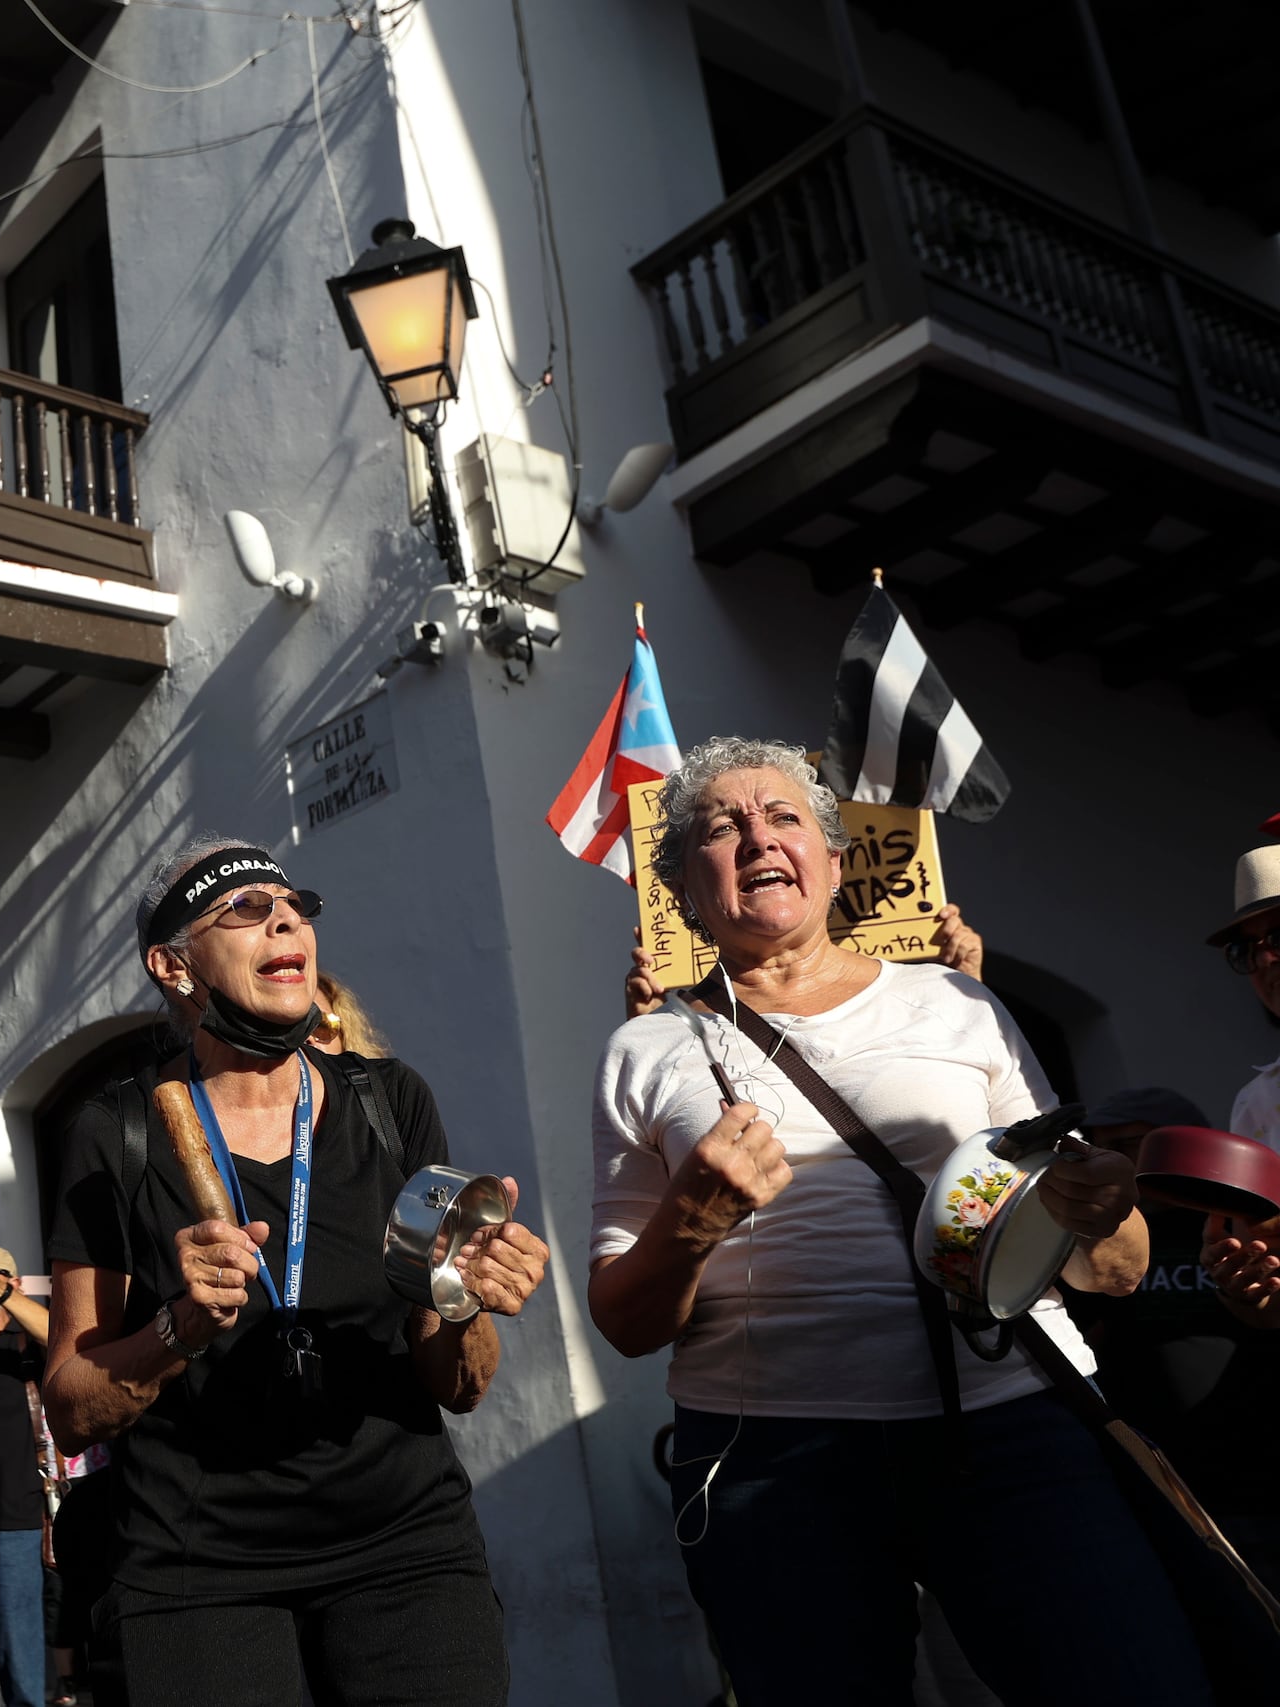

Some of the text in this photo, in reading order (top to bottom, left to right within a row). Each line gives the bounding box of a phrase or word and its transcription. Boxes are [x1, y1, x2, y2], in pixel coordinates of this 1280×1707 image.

[313, 714, 366, 763] CALLE
[325, 763, 339, 784] DE
[296, 1120, 310, 1166] Allegiant
